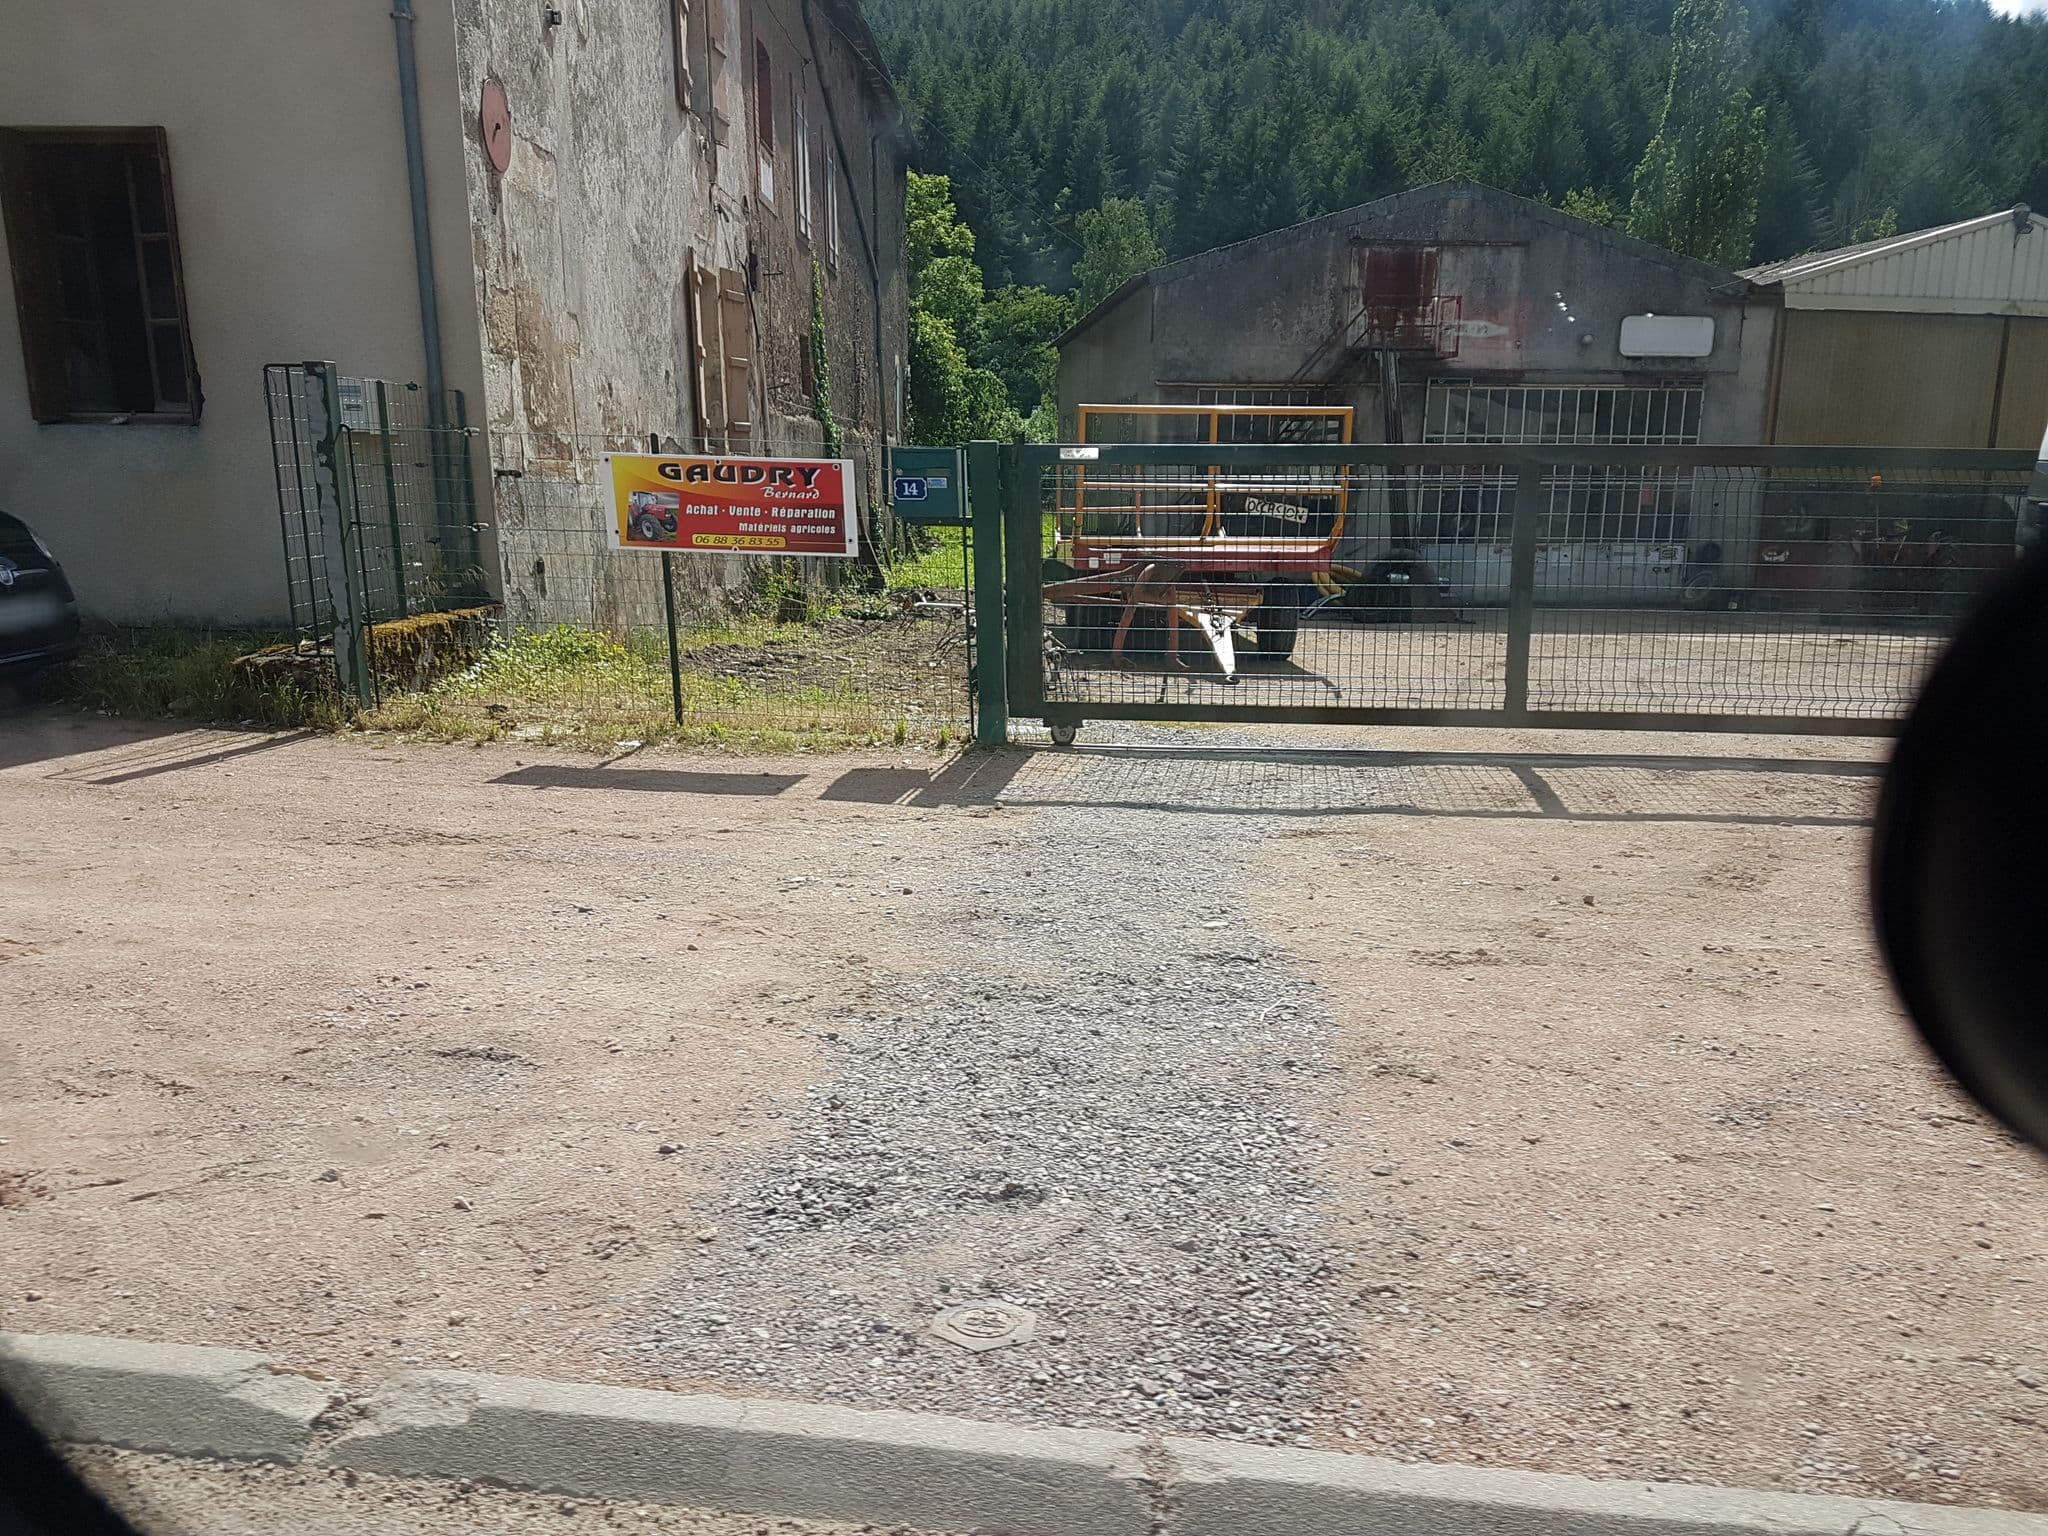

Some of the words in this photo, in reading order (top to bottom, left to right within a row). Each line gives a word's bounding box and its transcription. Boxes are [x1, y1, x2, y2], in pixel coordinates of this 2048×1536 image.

[657, 463, 821, 488] GAUDRY
[761, 486, 820, 499] Bernard
[903, 483, 919, 495] 14
[686, 504, 718, 515] Achat
[729, 505, 761, 517] Vente
[771, 506, 836, 519] Réparation
[738, 522, 787, 533] Matériels
[791, 524, 836, 535] agricoles
[695, 535, 710, 544] 06
[713, 536, 728, 545] 88
[730, 536, 746, 545] 36
[748, 537, 763, 546] 83
[765, 537, 780, 546] 55
